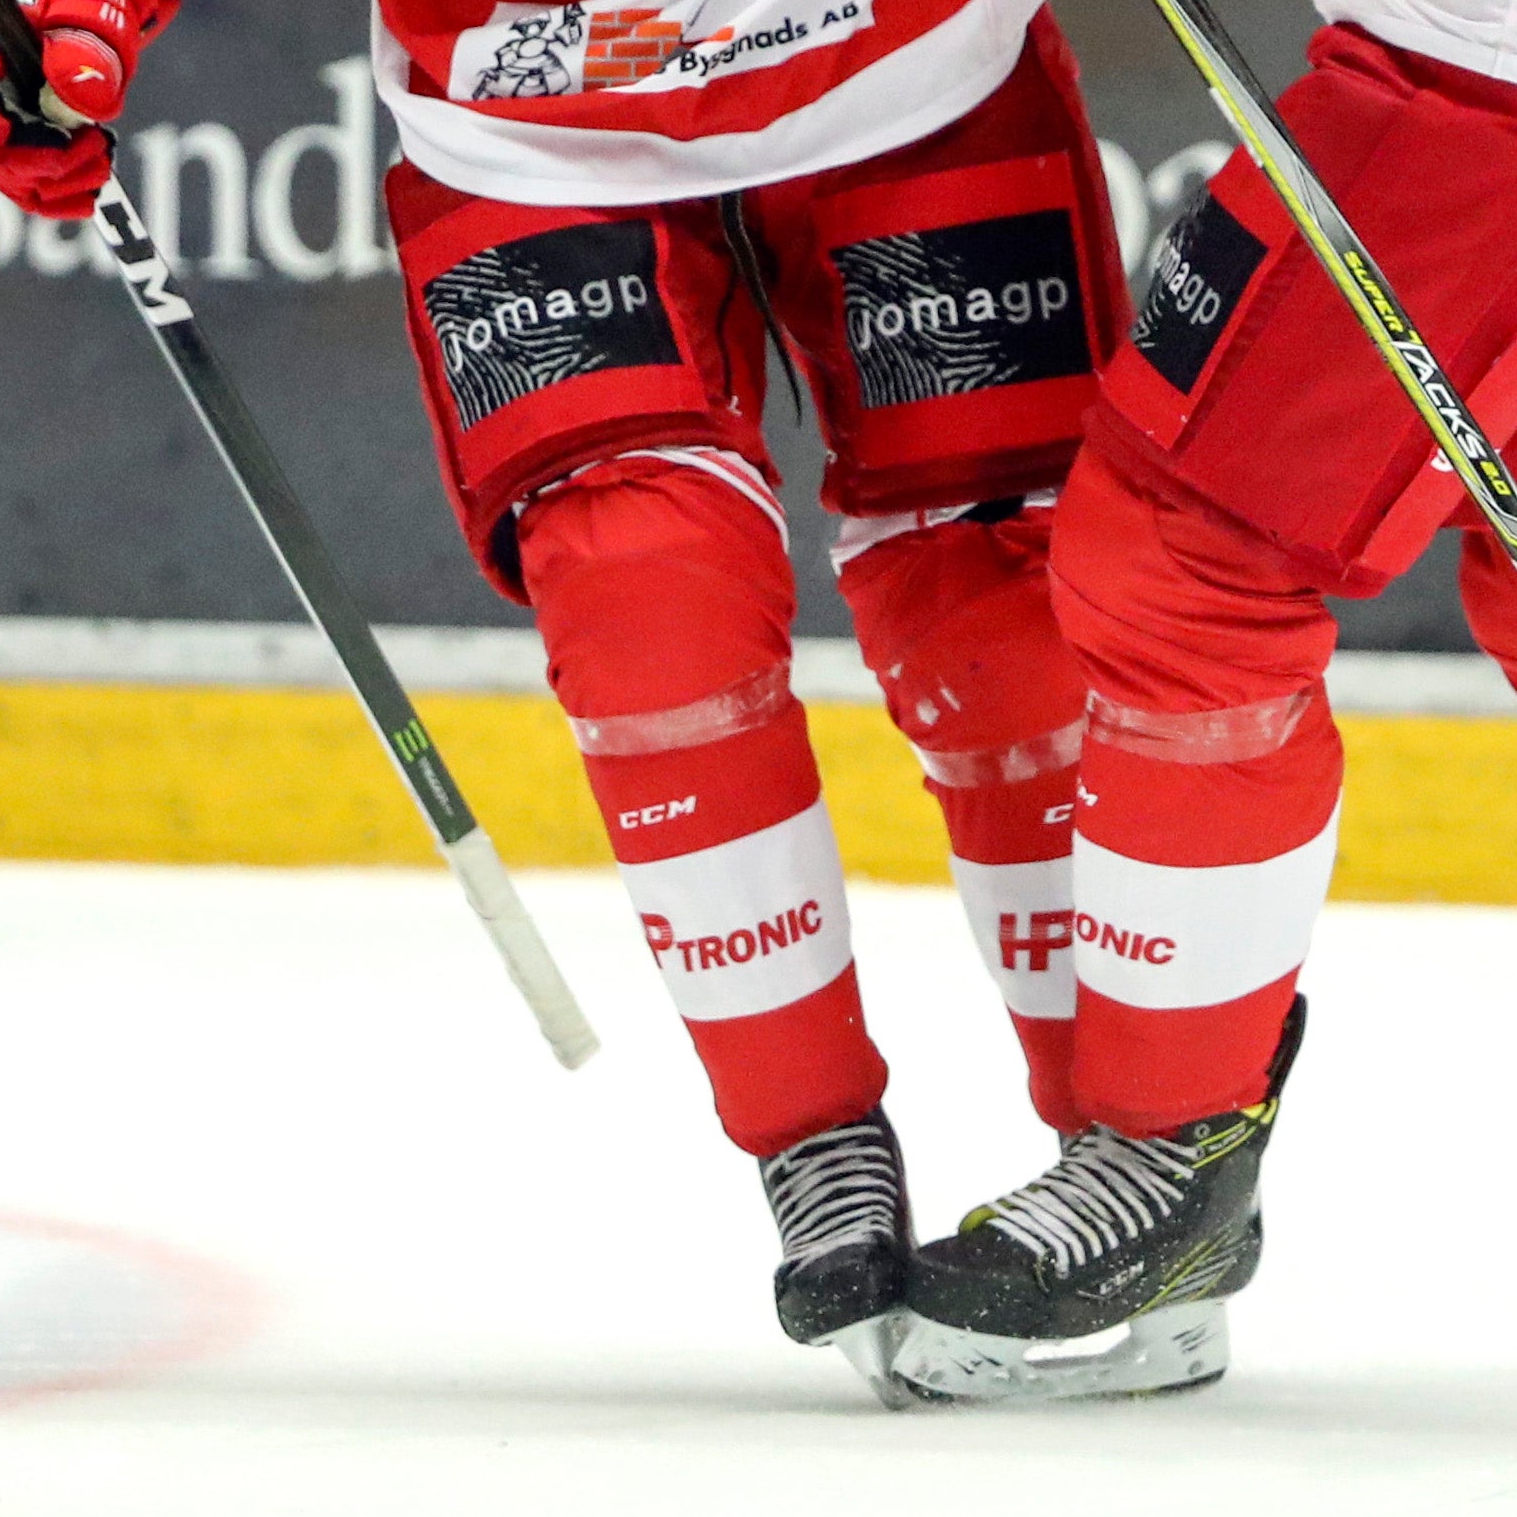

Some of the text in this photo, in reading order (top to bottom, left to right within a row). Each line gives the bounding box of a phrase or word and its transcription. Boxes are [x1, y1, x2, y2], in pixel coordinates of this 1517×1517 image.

[443, 273, 649, 373] jomagp
[857, 275, 1070, 351] jomagp
[1158, 243, 1221, 325] magp
[1343, 250, 1405, 333] SUPER
[619, 795, 698, 830] CCM
